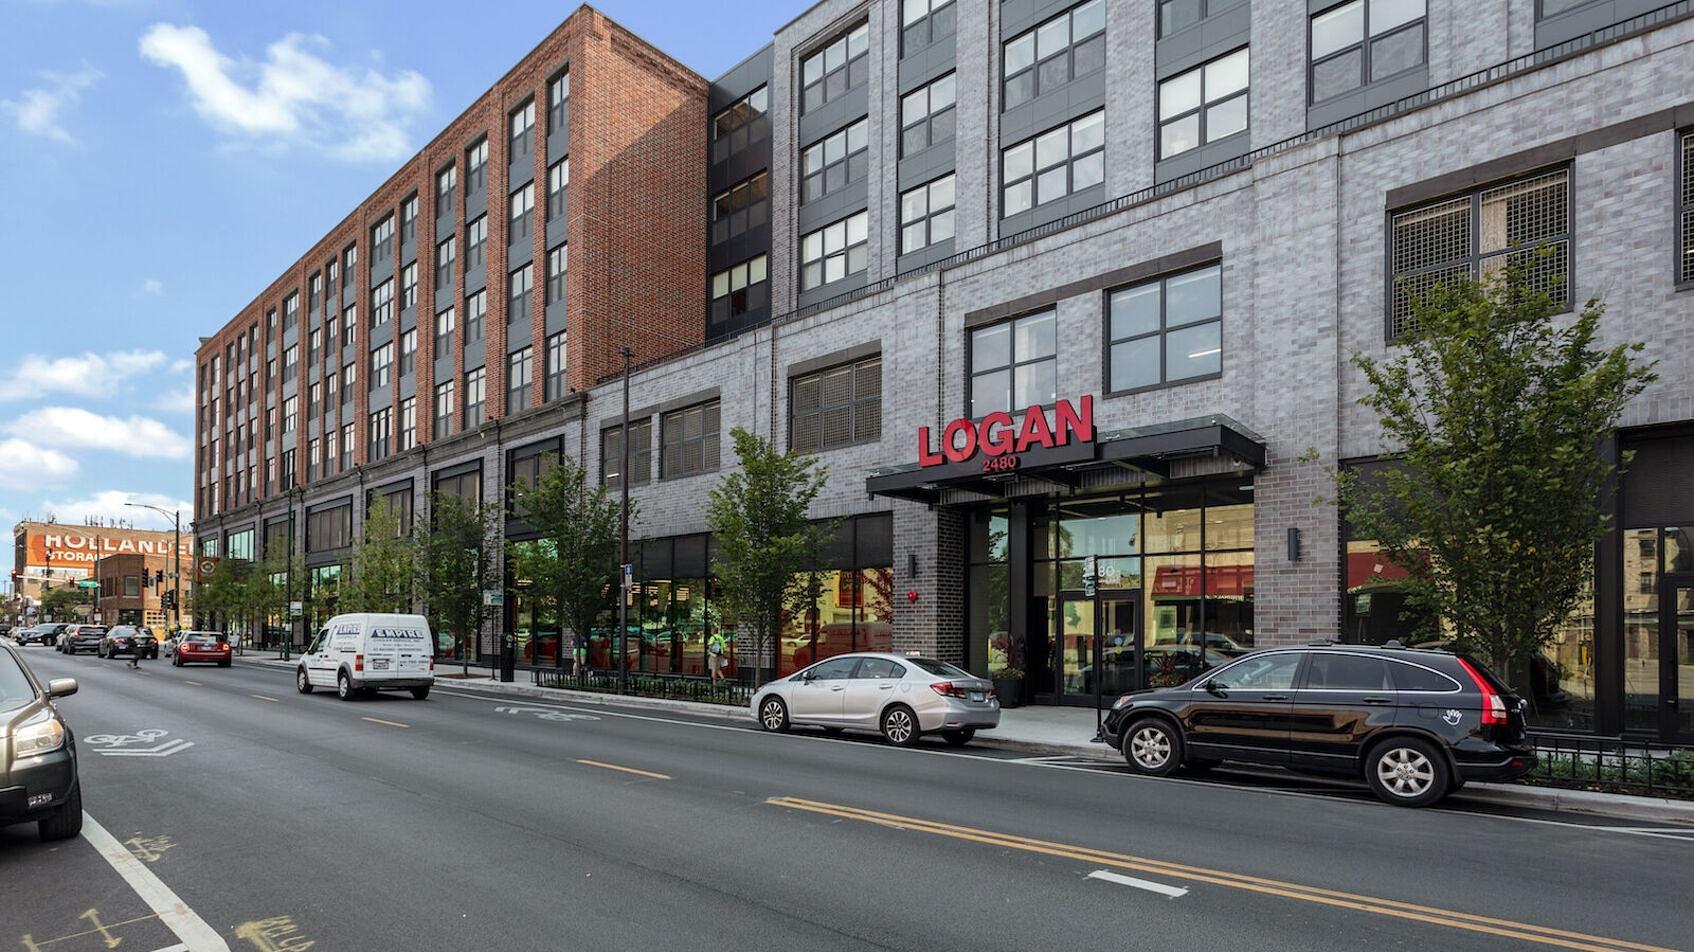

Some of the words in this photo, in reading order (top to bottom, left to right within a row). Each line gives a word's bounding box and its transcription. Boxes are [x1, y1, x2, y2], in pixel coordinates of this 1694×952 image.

[918, 394, 1094, 468] LOGAN
[983, 455, 1018, 472] 2480
[375, 628, 425, 639] EMPIRE
